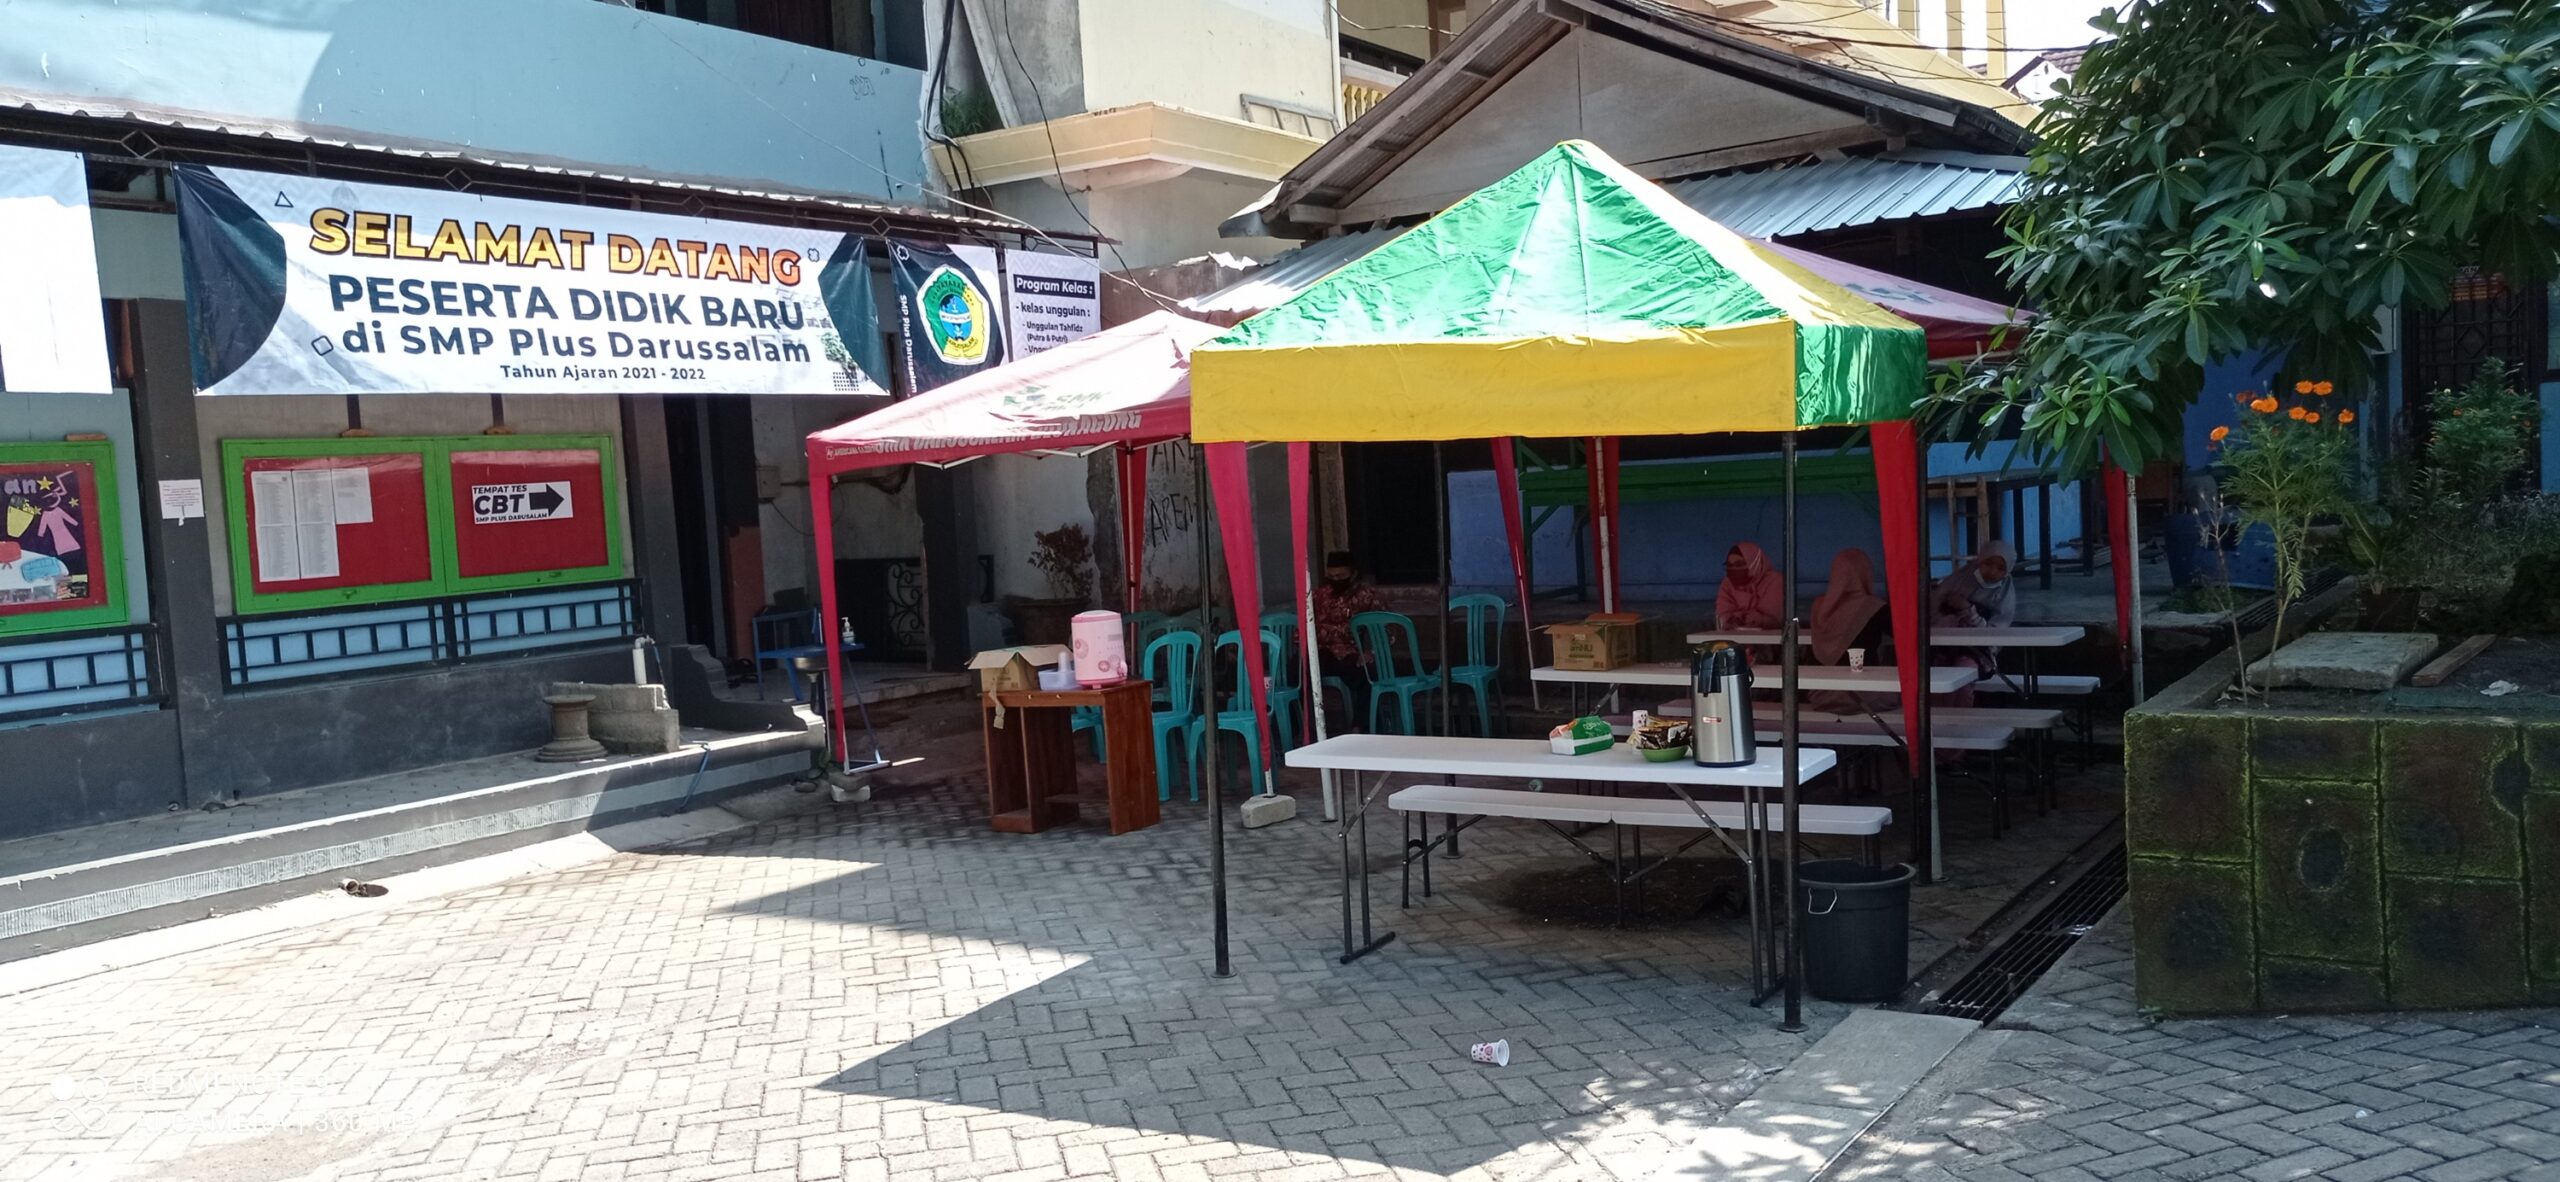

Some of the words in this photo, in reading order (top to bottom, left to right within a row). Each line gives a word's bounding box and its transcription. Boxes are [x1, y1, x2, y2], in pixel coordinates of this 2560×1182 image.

[309, 207, 595, 270] SELAMAT
[607, 232, 801, 287] DATANG
[1016, 277, 1060, 292] Program
[1062, 281, 1088, 294] Kelas
[329, 274, 559, 320] PESERTA
[569, 287, 692, 325] DIDIK
[700, 295, 805, 331] BARU
[900, 294, 909, 316] SMP
[1020, 301, 1044, 314] kelas
[1045, 305, 1086, 318] unggulan
[903, 317, 911, 338] Plus
[1026, 320, 1058, 332] Unggulan
[1060, 323, 1083, 332] Tahfidz
[342, 320, 386, 354] di
[400, 324, 494, 355] SMP
[509, 328, 597, 357] Plus
[607, 331, 811, 362] Darussalam
[500, 365, 557, 378] Tahun
[562, 365, 618, 381] Ajaran
[622, 367, 657, 379] 2021
[669, 368, 706, 380] 2022
[905, 338, 918, 393] Darussalam
[473, 486, 510, 495] TEMPAT
[511, 484, 528, 493] TES
[474, 494, 525, 515] CBT
